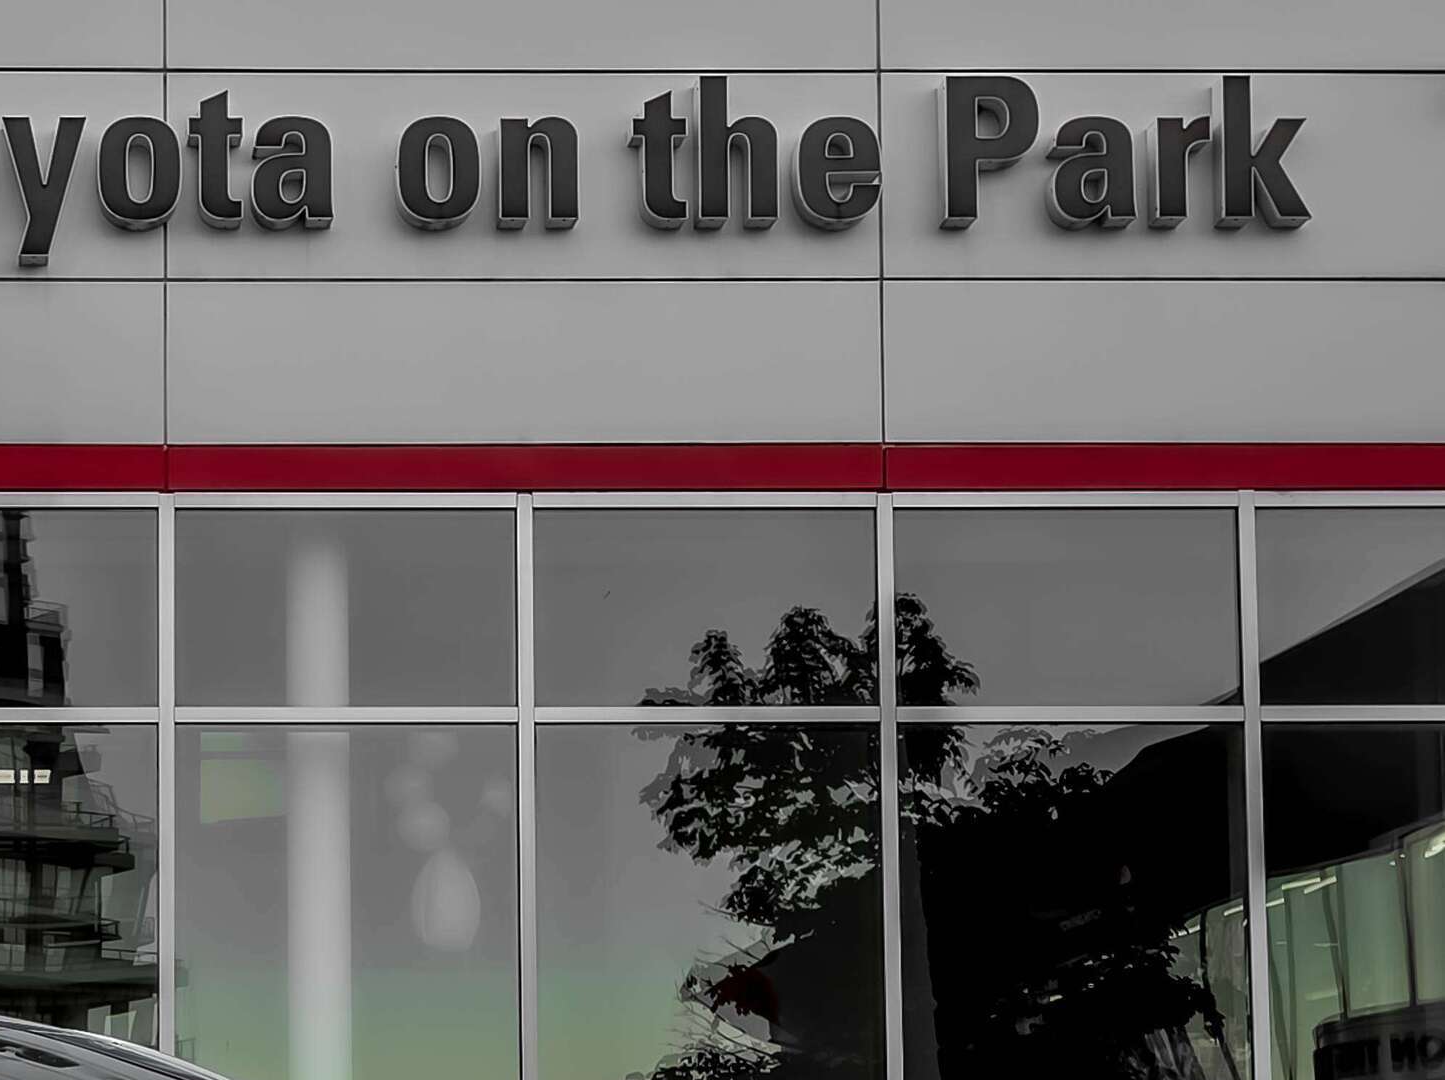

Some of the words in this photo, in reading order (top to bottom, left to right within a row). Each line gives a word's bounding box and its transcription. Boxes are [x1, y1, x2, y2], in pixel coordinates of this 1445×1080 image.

[395, 115, 580, 235] on
[630, 75, 884, 235] the
[936, 75, 1313, 235] Park
